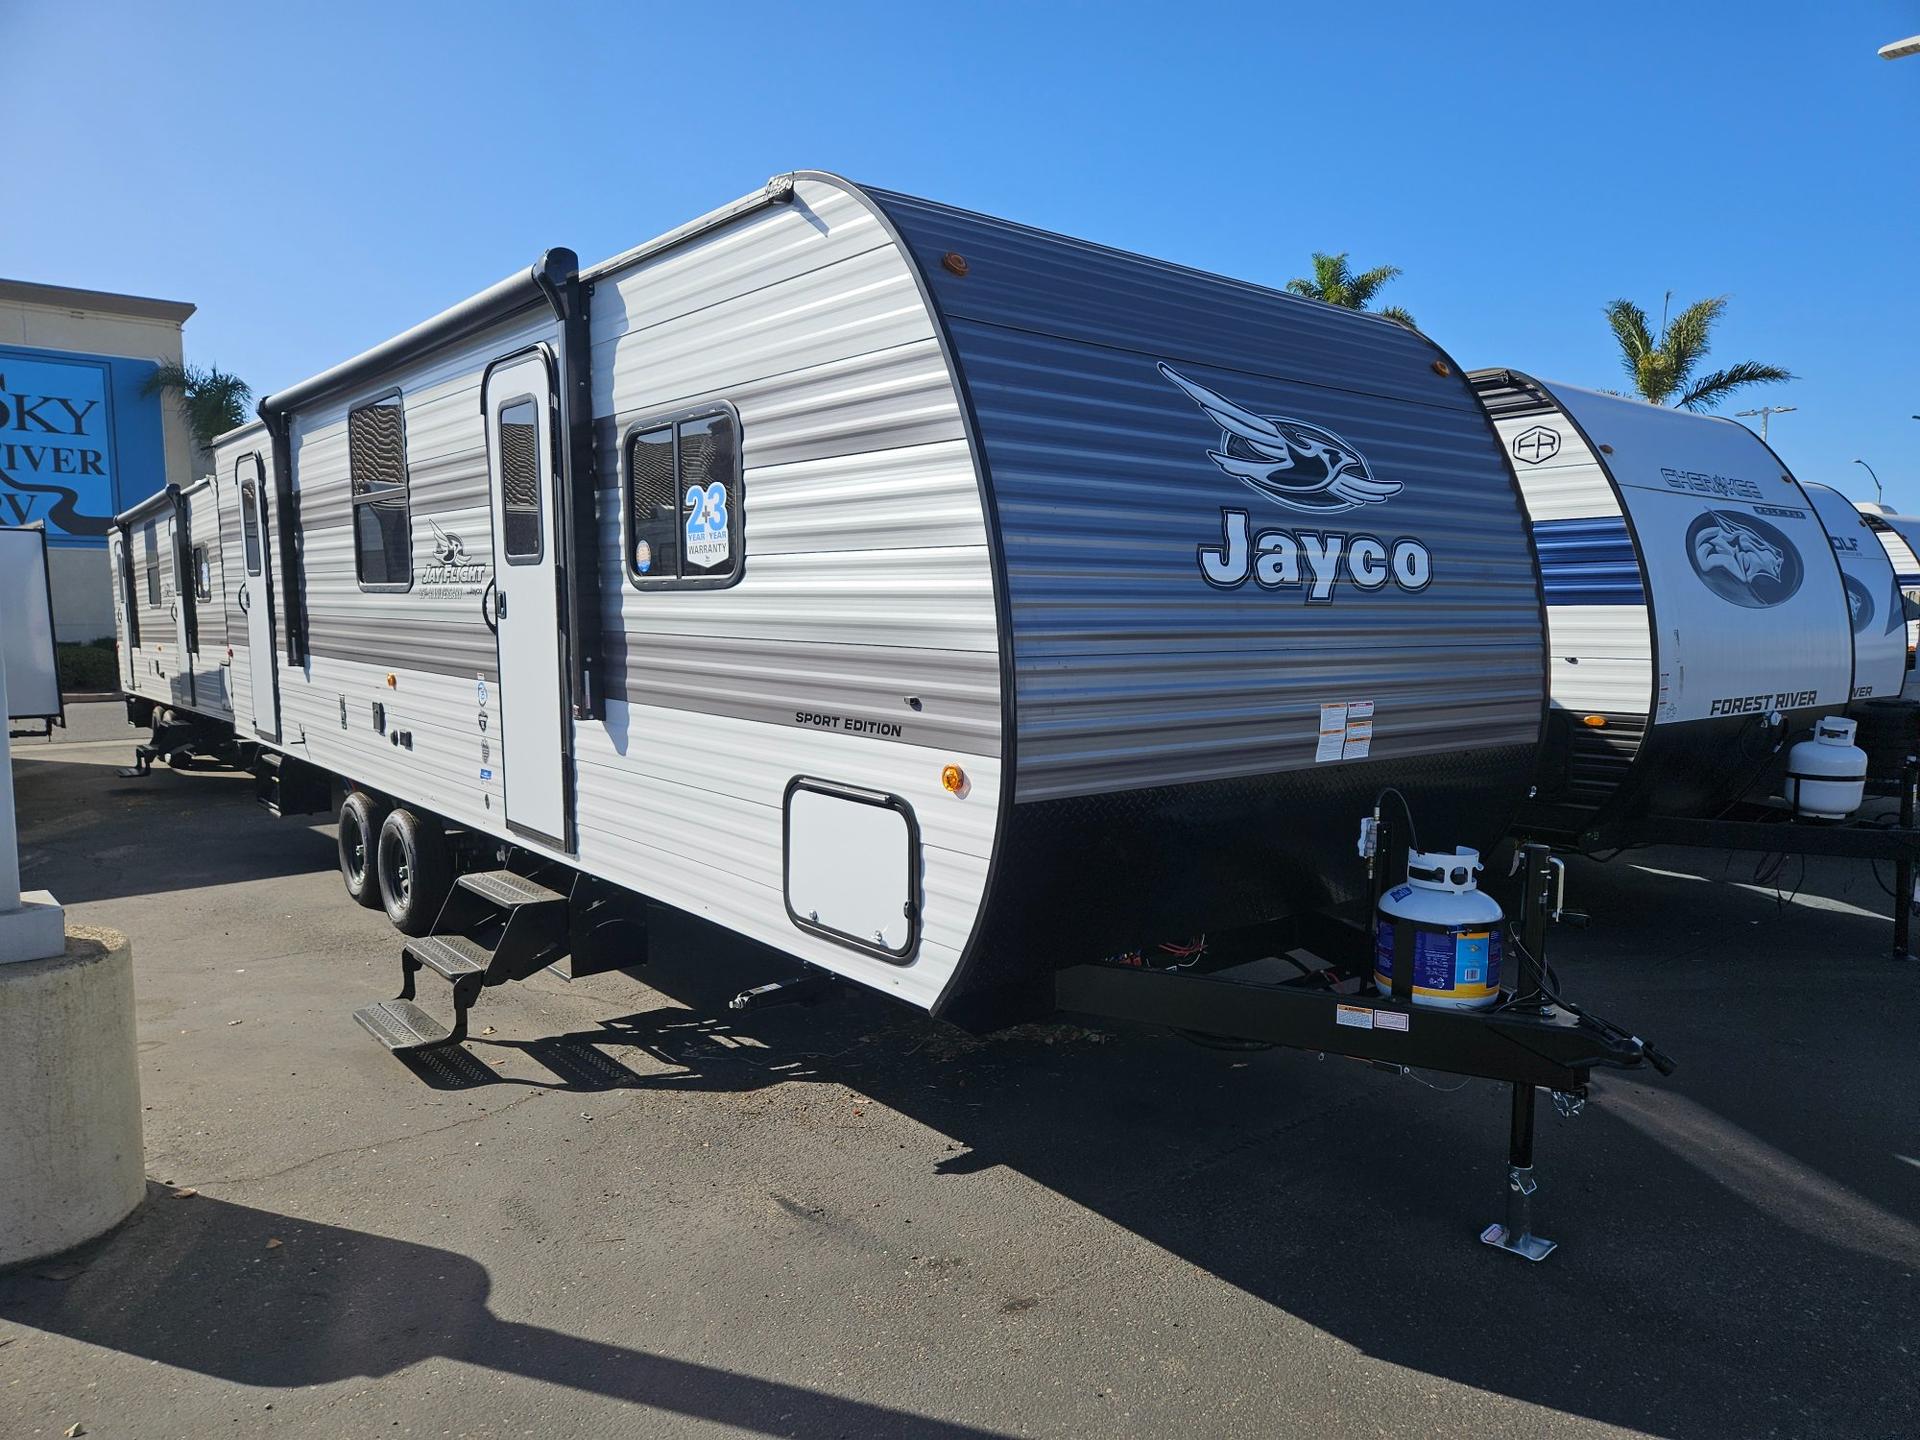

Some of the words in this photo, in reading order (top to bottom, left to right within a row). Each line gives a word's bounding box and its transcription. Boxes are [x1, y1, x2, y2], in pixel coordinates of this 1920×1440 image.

[0, 443, 106, 476] IVER
[709, 531, 727, 539] YEAR
[1832, 536, 1858, 551] OLF
[688, 543, 727, 554] WARRANTY
[1198, 506, 1433, 606] Jayco
[442, 564, 486, 583] FLIGHT
[1710, 695, 1773, 716] FOREST
[1774, 690, 1817, 709] RIVER
[795, 712, 840, 728] SPORT
[844, 718, 902, 737] EDITION
